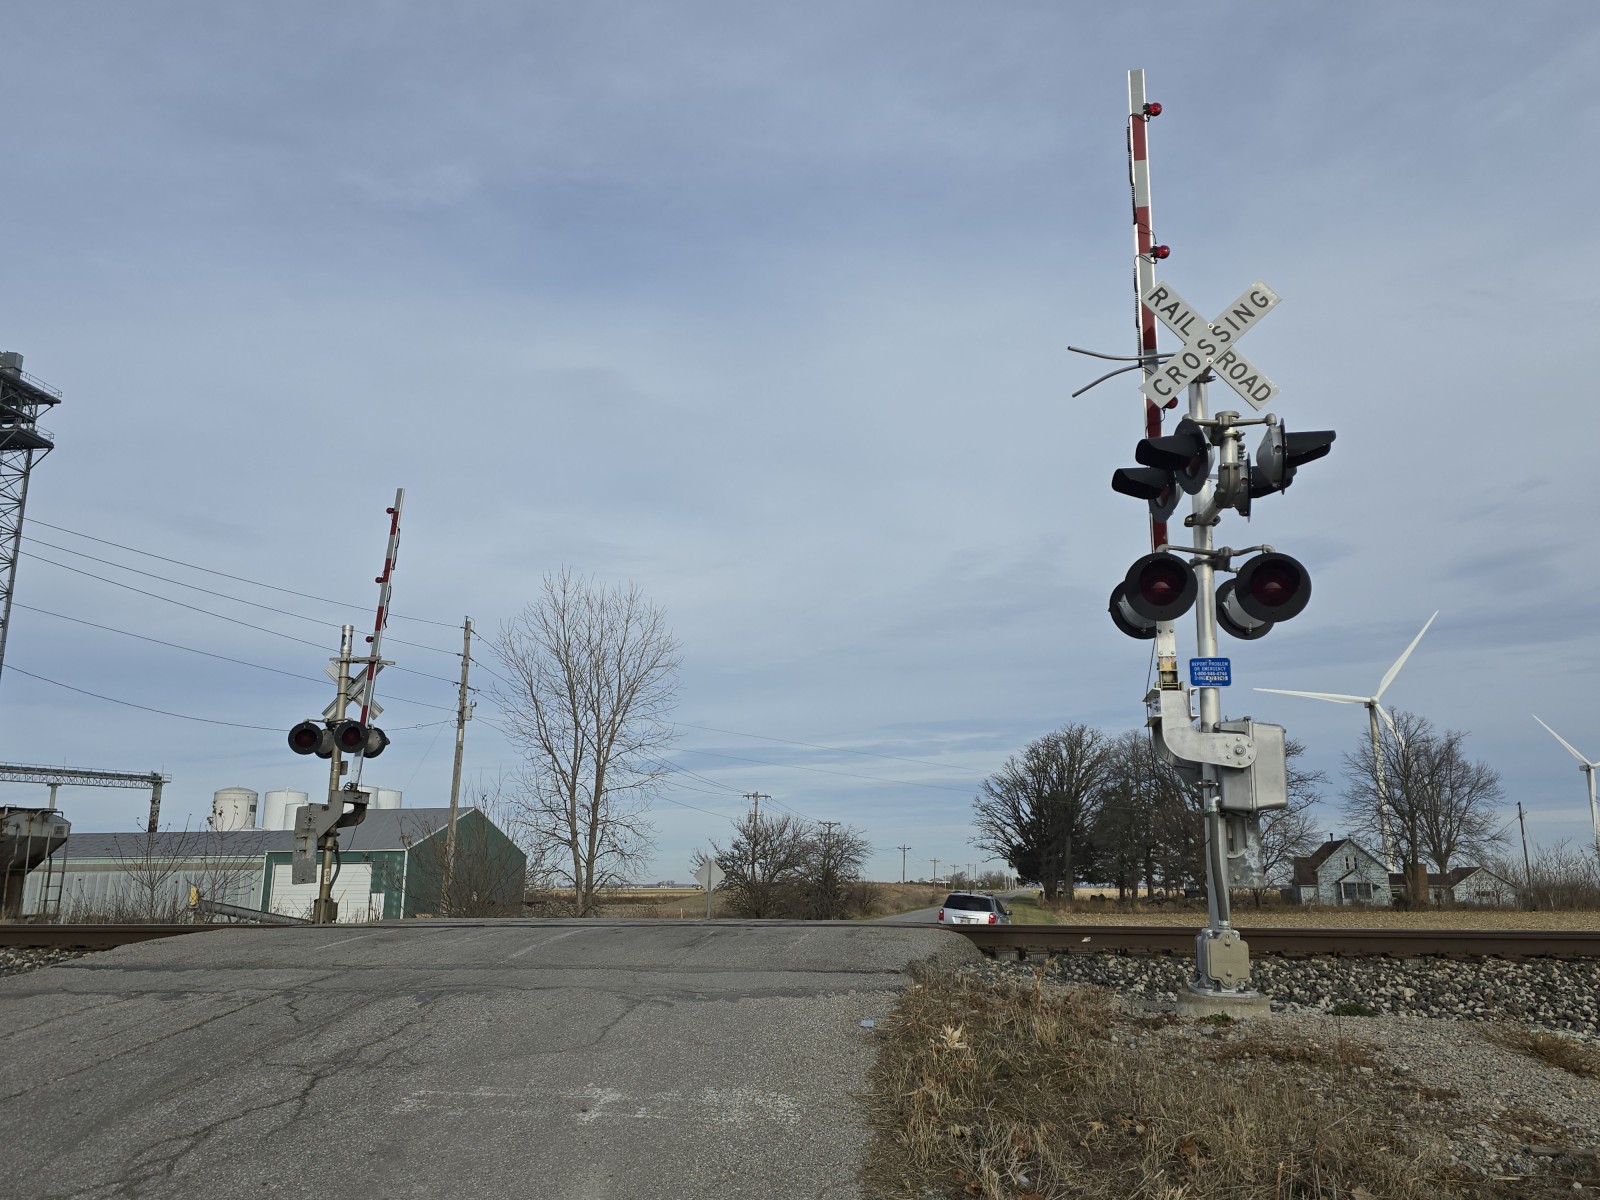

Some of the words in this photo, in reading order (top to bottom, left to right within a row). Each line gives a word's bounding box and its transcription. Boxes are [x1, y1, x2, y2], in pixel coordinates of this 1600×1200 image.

[1148, 287, 1196, 337] RAIL
[1216, 350, 1272, 402] ROAD
[1153, 290, 1269, 396] CROSSING
